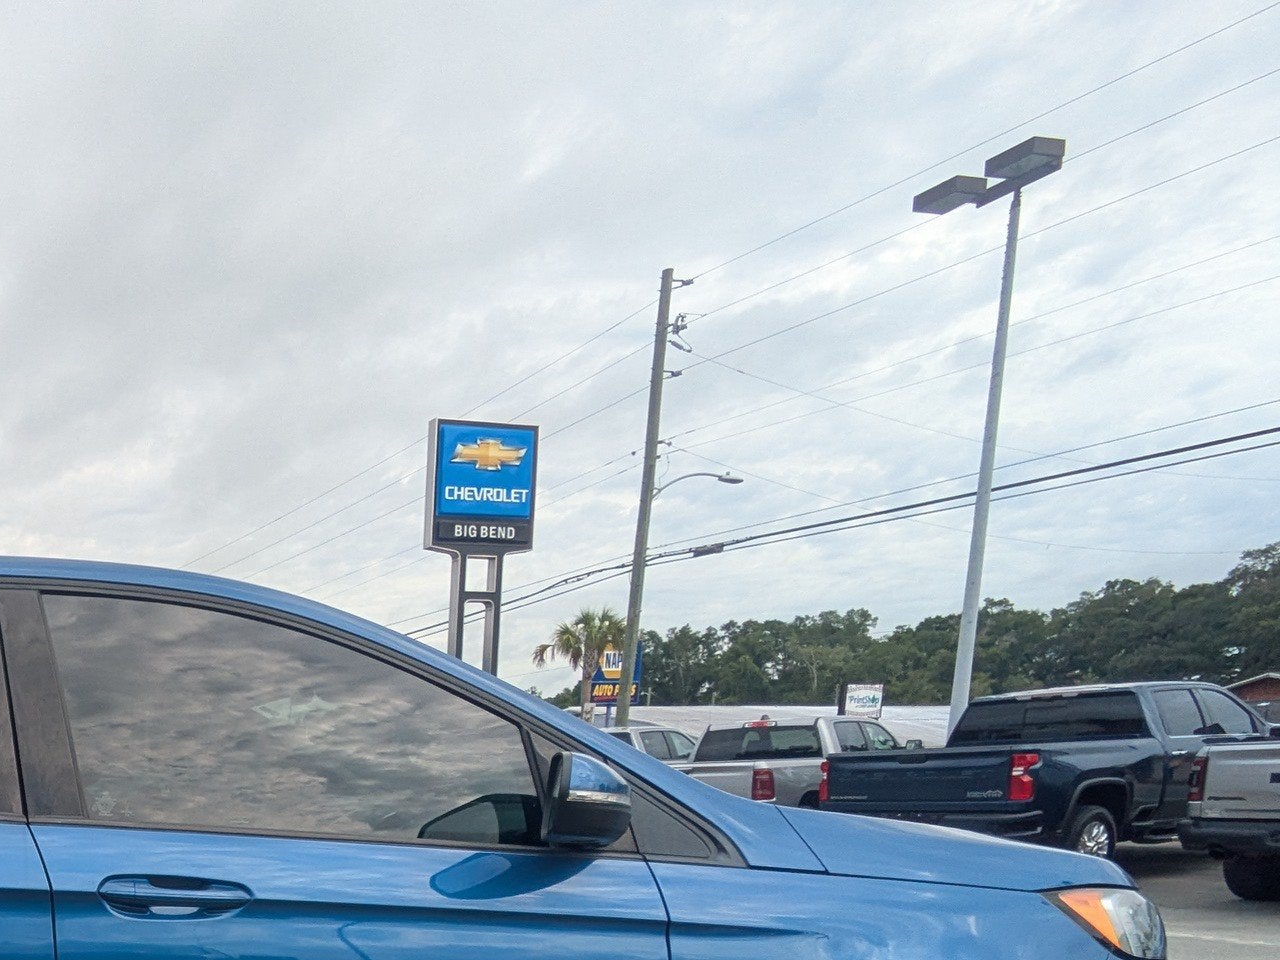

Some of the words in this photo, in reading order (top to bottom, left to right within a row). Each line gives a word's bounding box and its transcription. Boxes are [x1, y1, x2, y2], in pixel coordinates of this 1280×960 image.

[444, 486, 530, 503] CHEVROLET
[454, 524, 478, 538] BIG
[480, 525, 516, 539] BEND
[605, 652, 623, 669] NAP
[592, 684, 614, 697] AUTO
